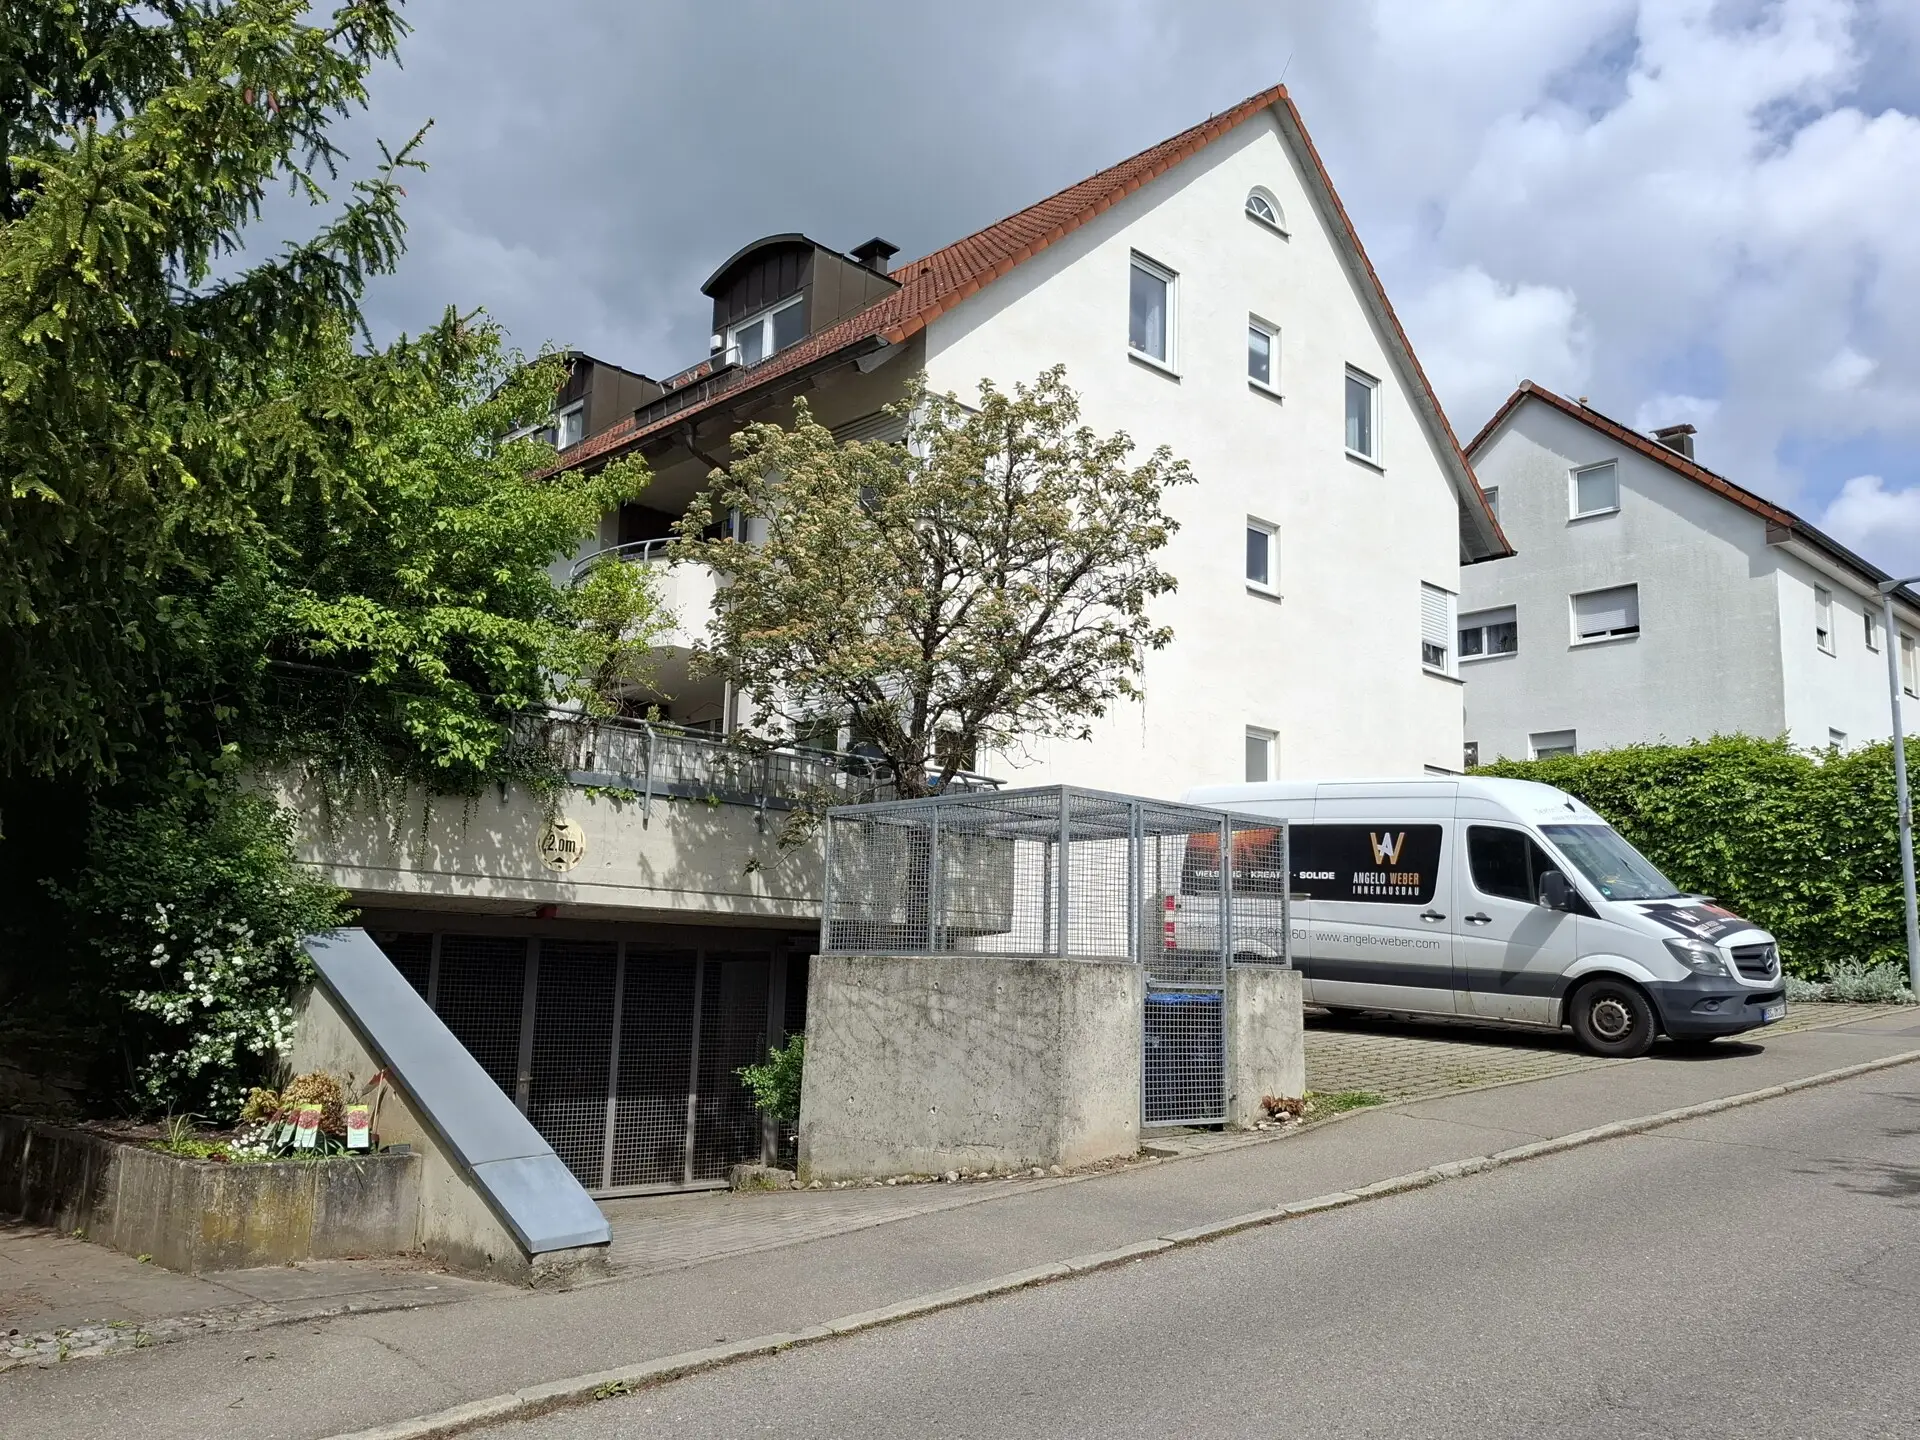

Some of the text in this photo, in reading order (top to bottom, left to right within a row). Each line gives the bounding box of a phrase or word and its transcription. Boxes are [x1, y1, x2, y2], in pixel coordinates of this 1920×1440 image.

[1299, 871, 1336, 880] SOLIDE
[1352, 872, 1419, 885] ANGELO WEBER
[1352, 885, 1419, 896] INNENAUSBAU
[1316, 932, 1440, 949] www.angelo-weber.com
